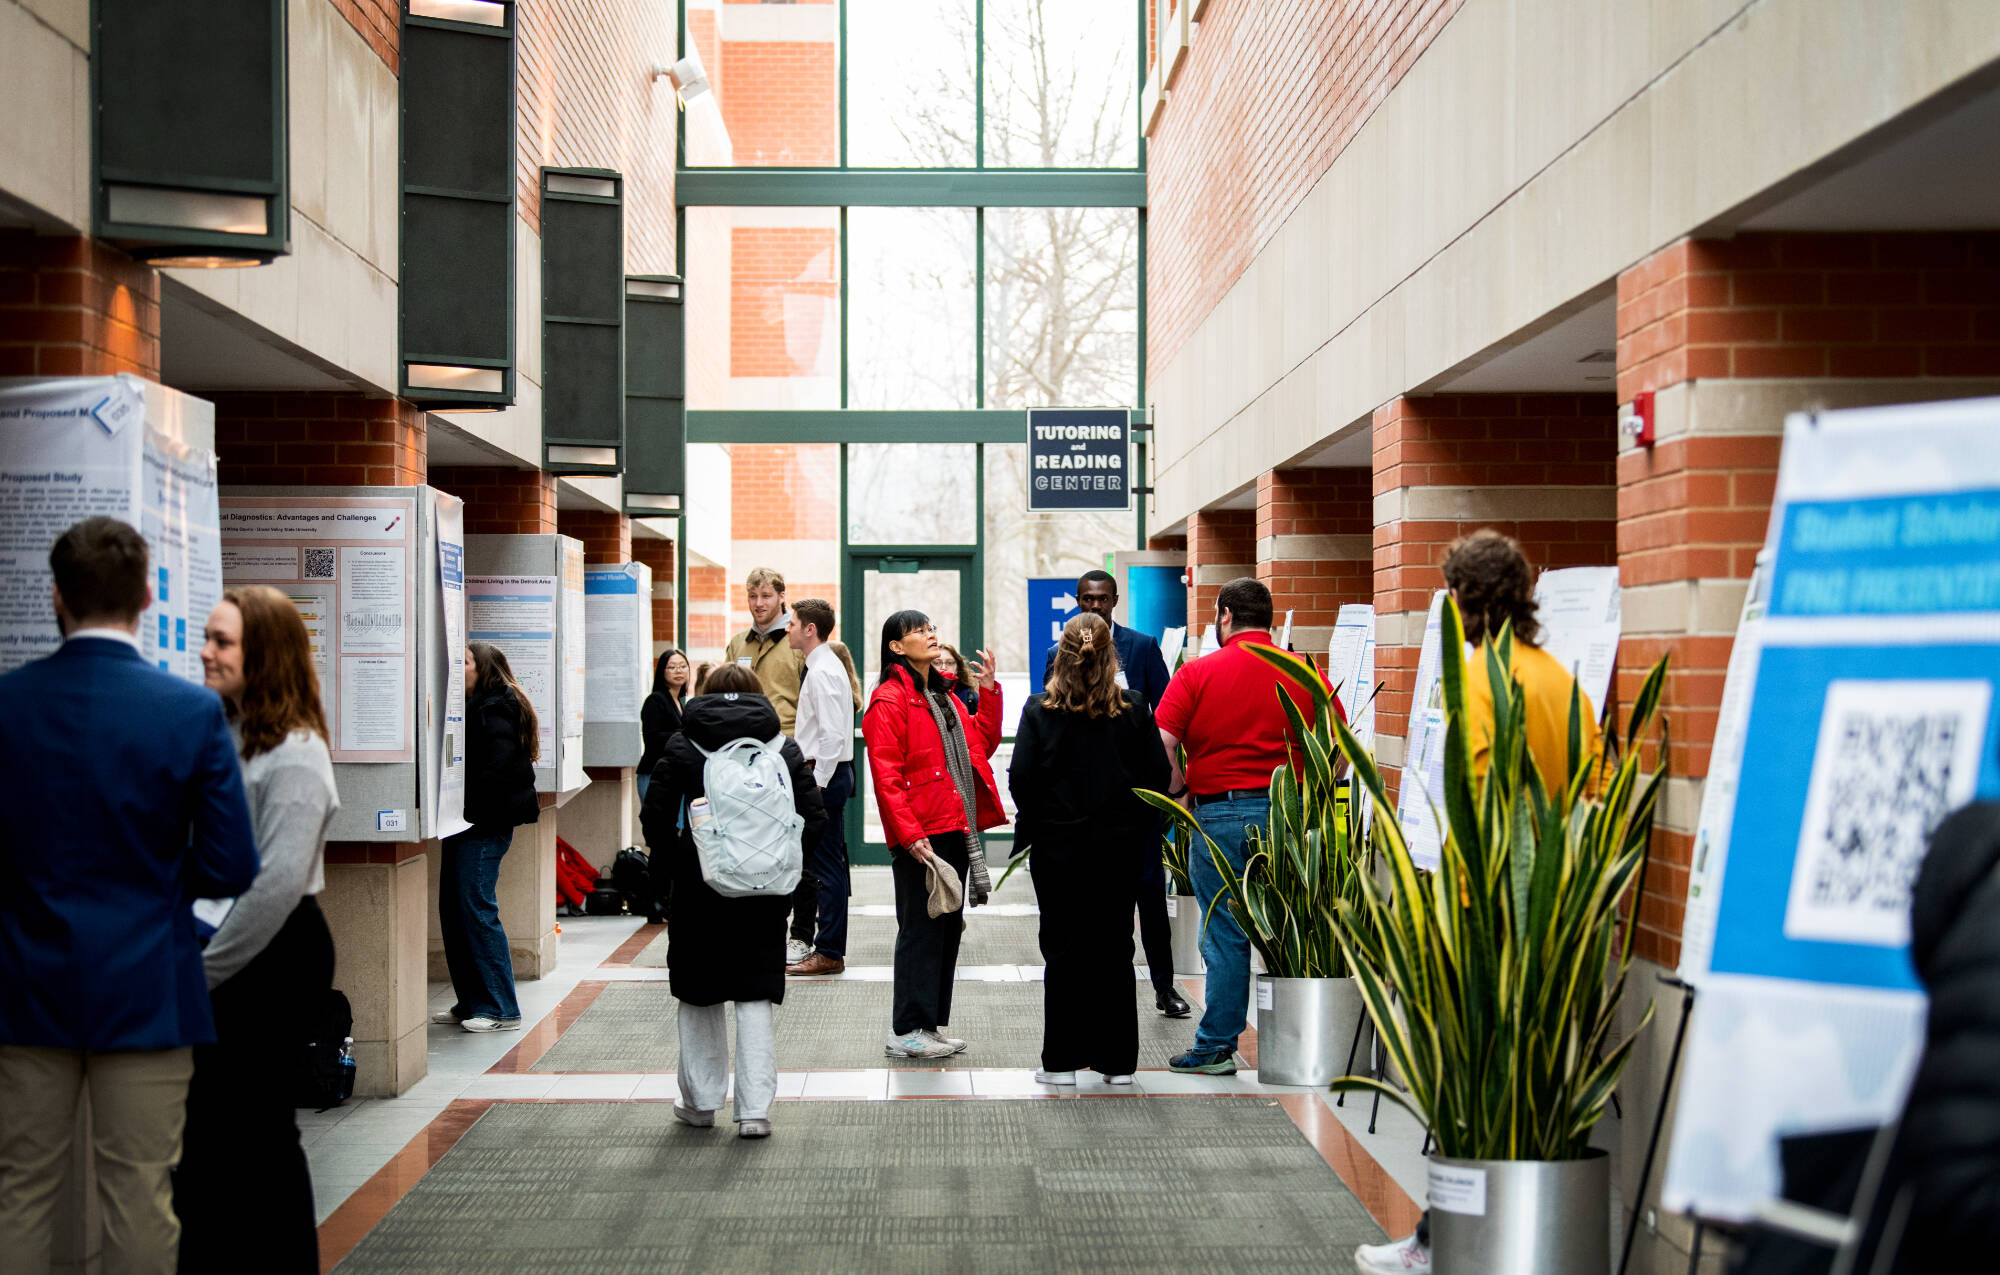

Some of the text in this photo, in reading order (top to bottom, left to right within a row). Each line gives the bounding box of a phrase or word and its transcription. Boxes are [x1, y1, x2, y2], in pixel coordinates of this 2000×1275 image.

[23, 408, 76, 419] Proposed
[1035, 425, 1122, 440] TUTORING
[1070, 442, 1086, 451] and
[1035, 454, 1122, 469] READING
[1, 472, 83, 484] Proposed Study
[1035, 475, 1121, 490] CENTER
[230, 513, 275, 522] Diagnostics:
[277, 513, 319, 522] Advantages
[321, 513, 335, 521] and
[337, 513, 377, 522] Challenges
[385, 819, 398, 827] 031
